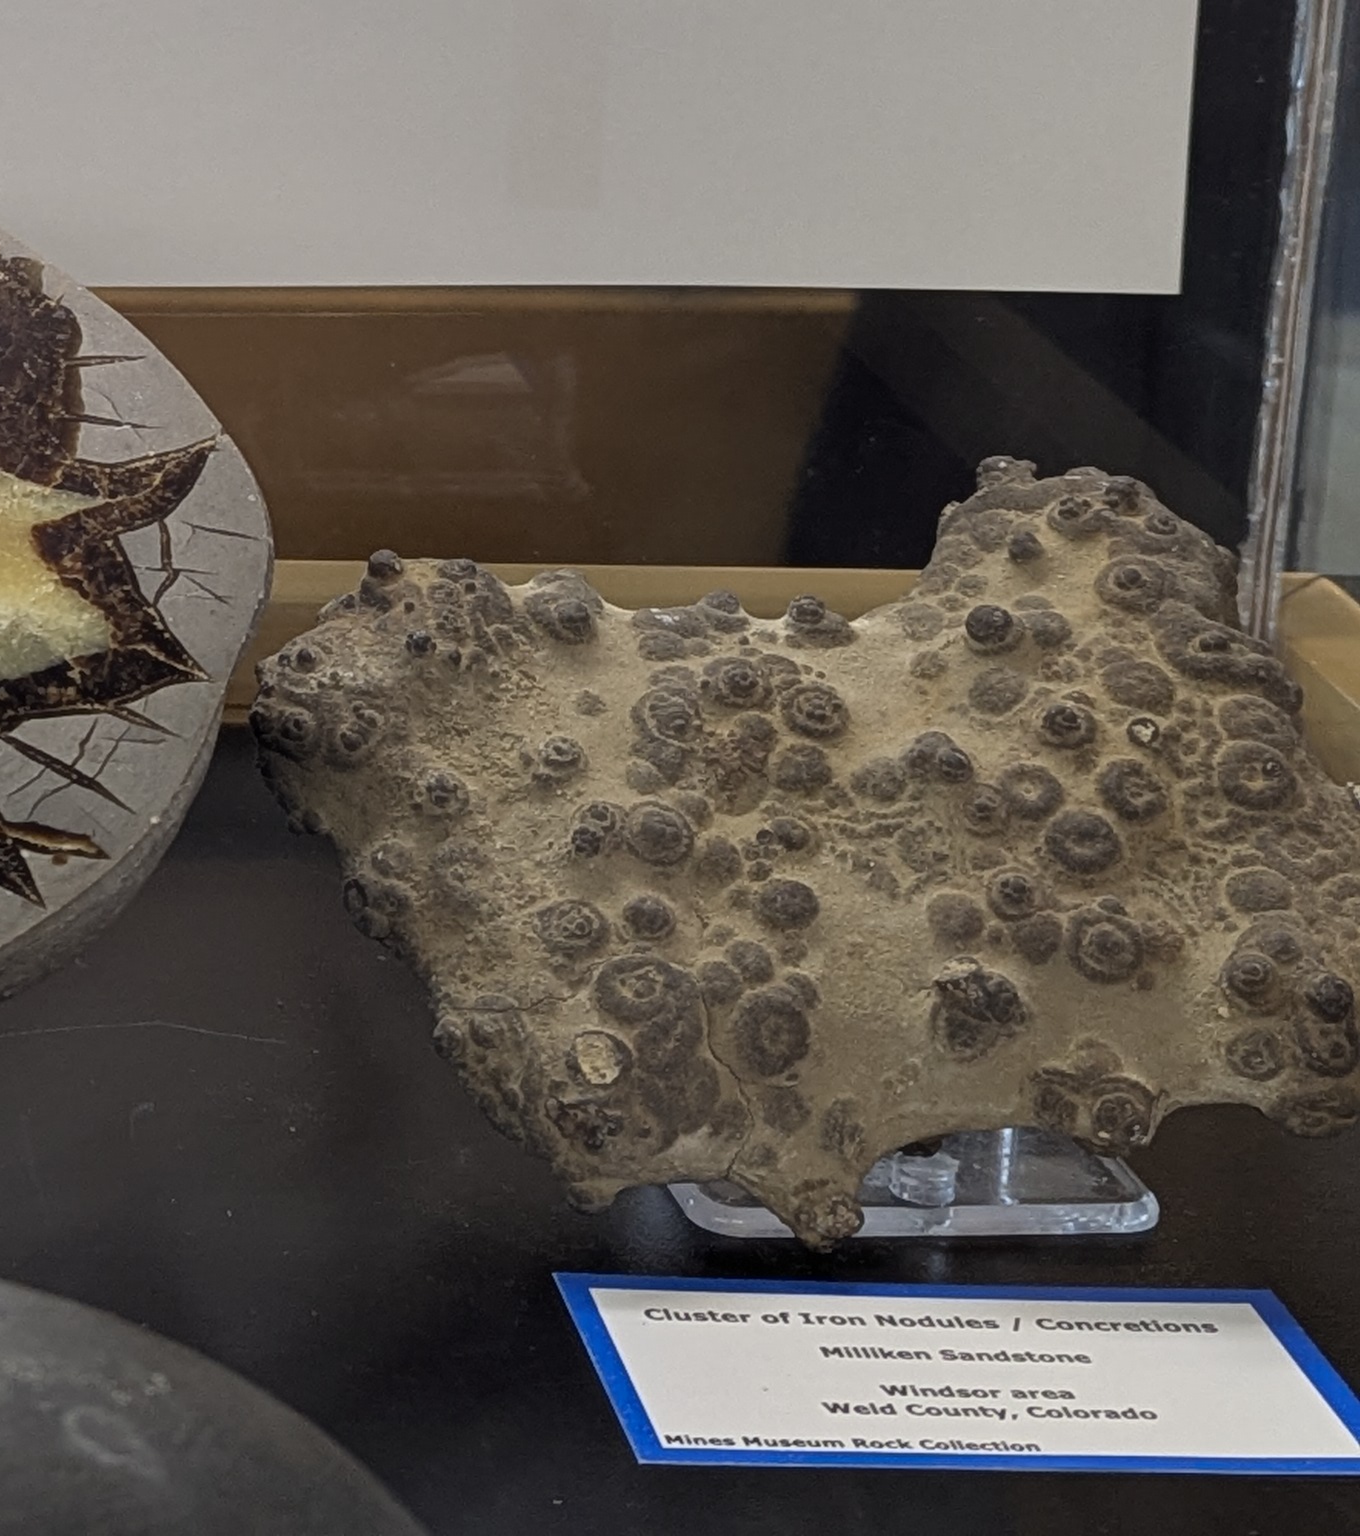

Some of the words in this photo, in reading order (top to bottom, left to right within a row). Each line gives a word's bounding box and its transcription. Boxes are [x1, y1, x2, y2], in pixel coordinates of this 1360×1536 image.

[645, 1309, 750, 1322] Cluster
[762, 1313, 789, 1323] of
[799, 1313, 866, 1325] Iron
[875, 1315, 999, 1328] Nodules
[1014, 1318, 1020, 1331] /
[1036, 1319, 1218, 1333] Concretions
[820, 1347, 932, 1360] Milliken
[939, 1350, 1091, 1363] Sandstone
[880, 1385, 1000, 1398] Windsor
[1011, 1390, 1075, 1399] area
[822, 1402, 897, 1415] Weld
[906, 1404, 1017, 1420] County,
[1027, 1407, 1157, 1419] Colorado
[665, 1436, 735, 1445] Mines
[743, 1437, 844, 1447] Museum
[852, 1439, 910, 1448] Rock
[920, 1440, 1039, 1451] Collection
